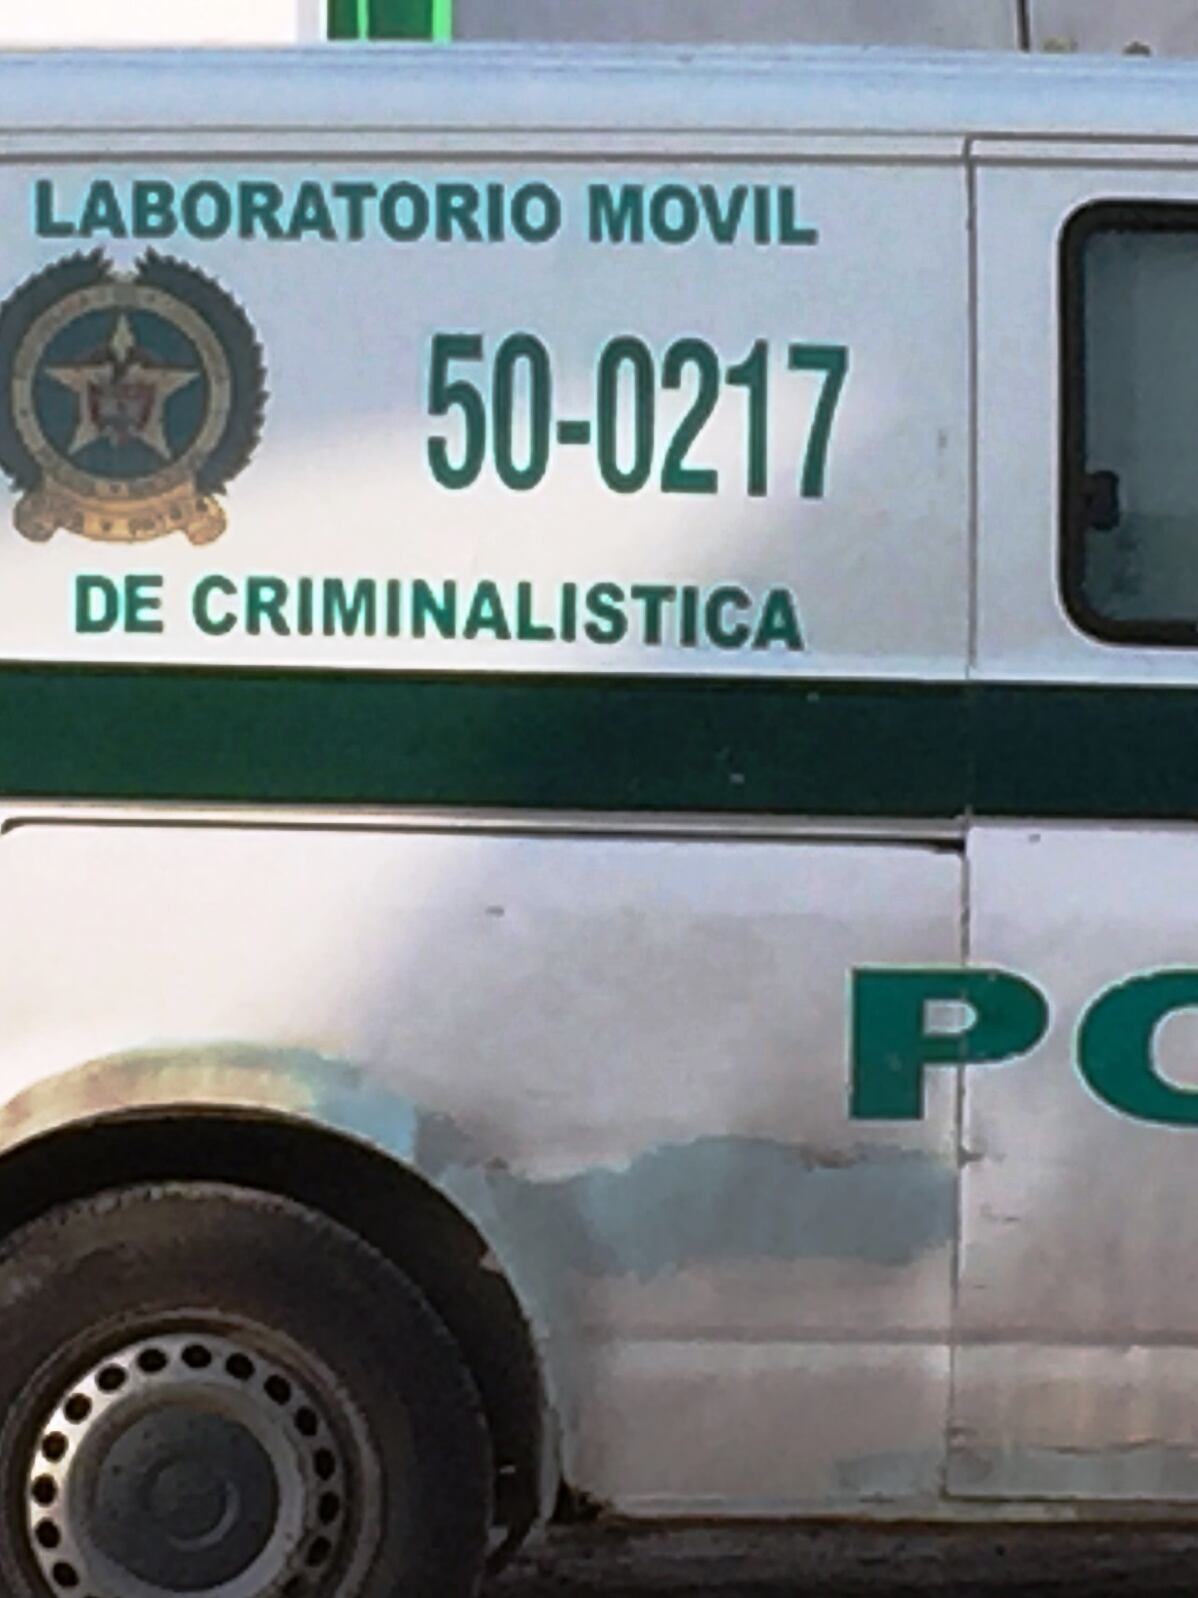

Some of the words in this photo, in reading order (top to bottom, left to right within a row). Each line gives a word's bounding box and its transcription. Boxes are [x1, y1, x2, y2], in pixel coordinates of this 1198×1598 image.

[34, 179, 561, 243] LABORATORIO
[588, 183, 819, 245] MOVIL
[426, 333, 850, 498] 50-0217
[74, 575, 164, 633] DE
[191, 575, 804, 651] CRIMINALISTICA
